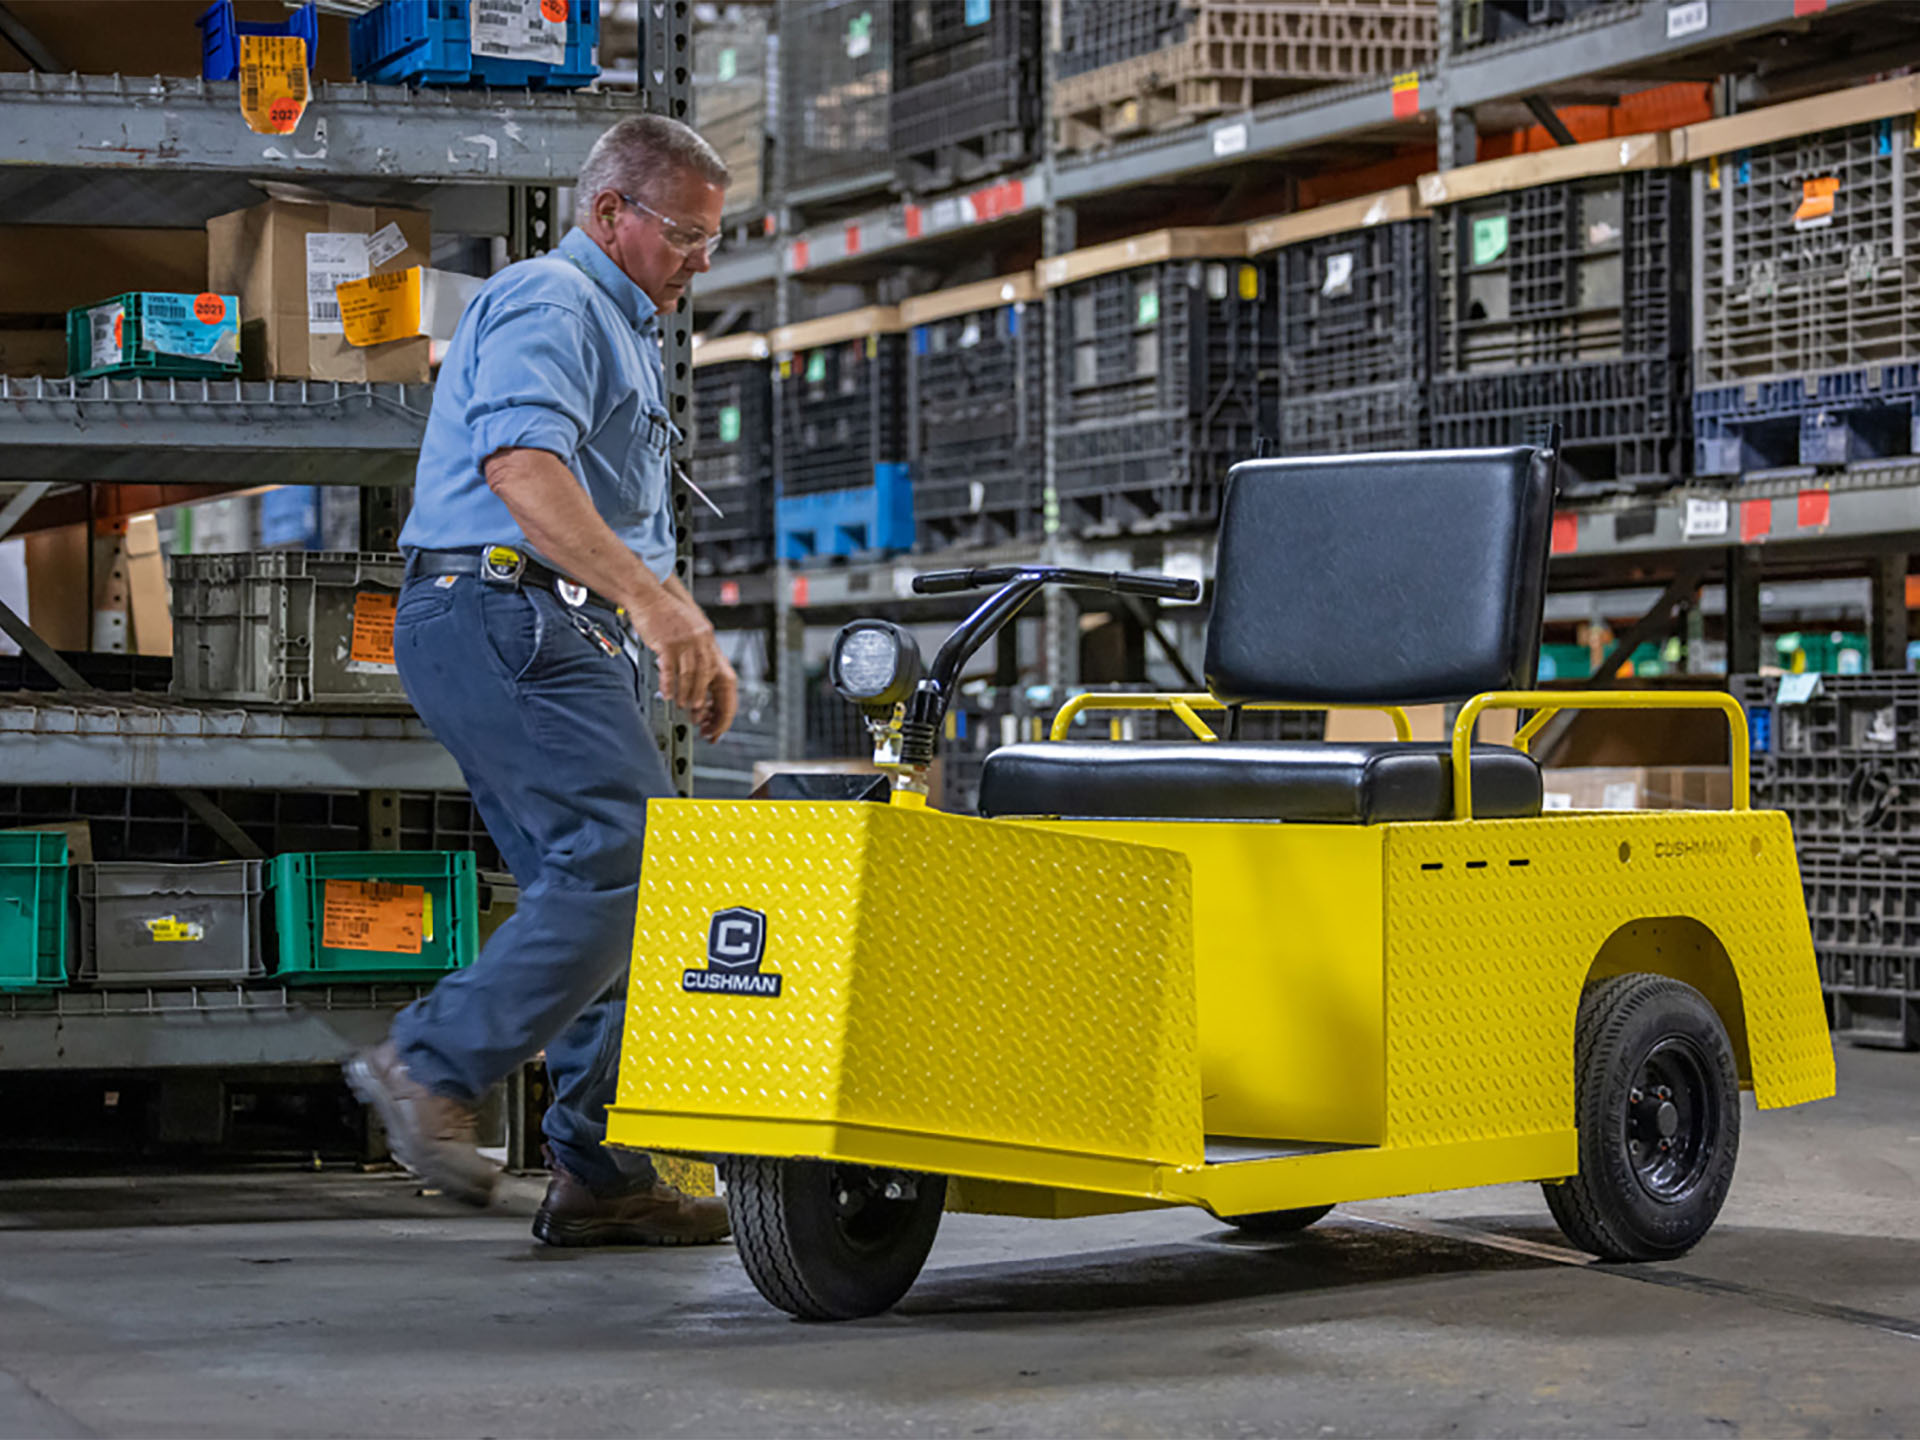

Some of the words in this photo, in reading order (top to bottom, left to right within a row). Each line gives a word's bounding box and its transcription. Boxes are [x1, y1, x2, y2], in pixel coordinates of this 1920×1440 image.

[196, 303, 222, 315] 2021
[716, 919, 753, 955] C
[684, 971, 777, 993] CUSHMAN
